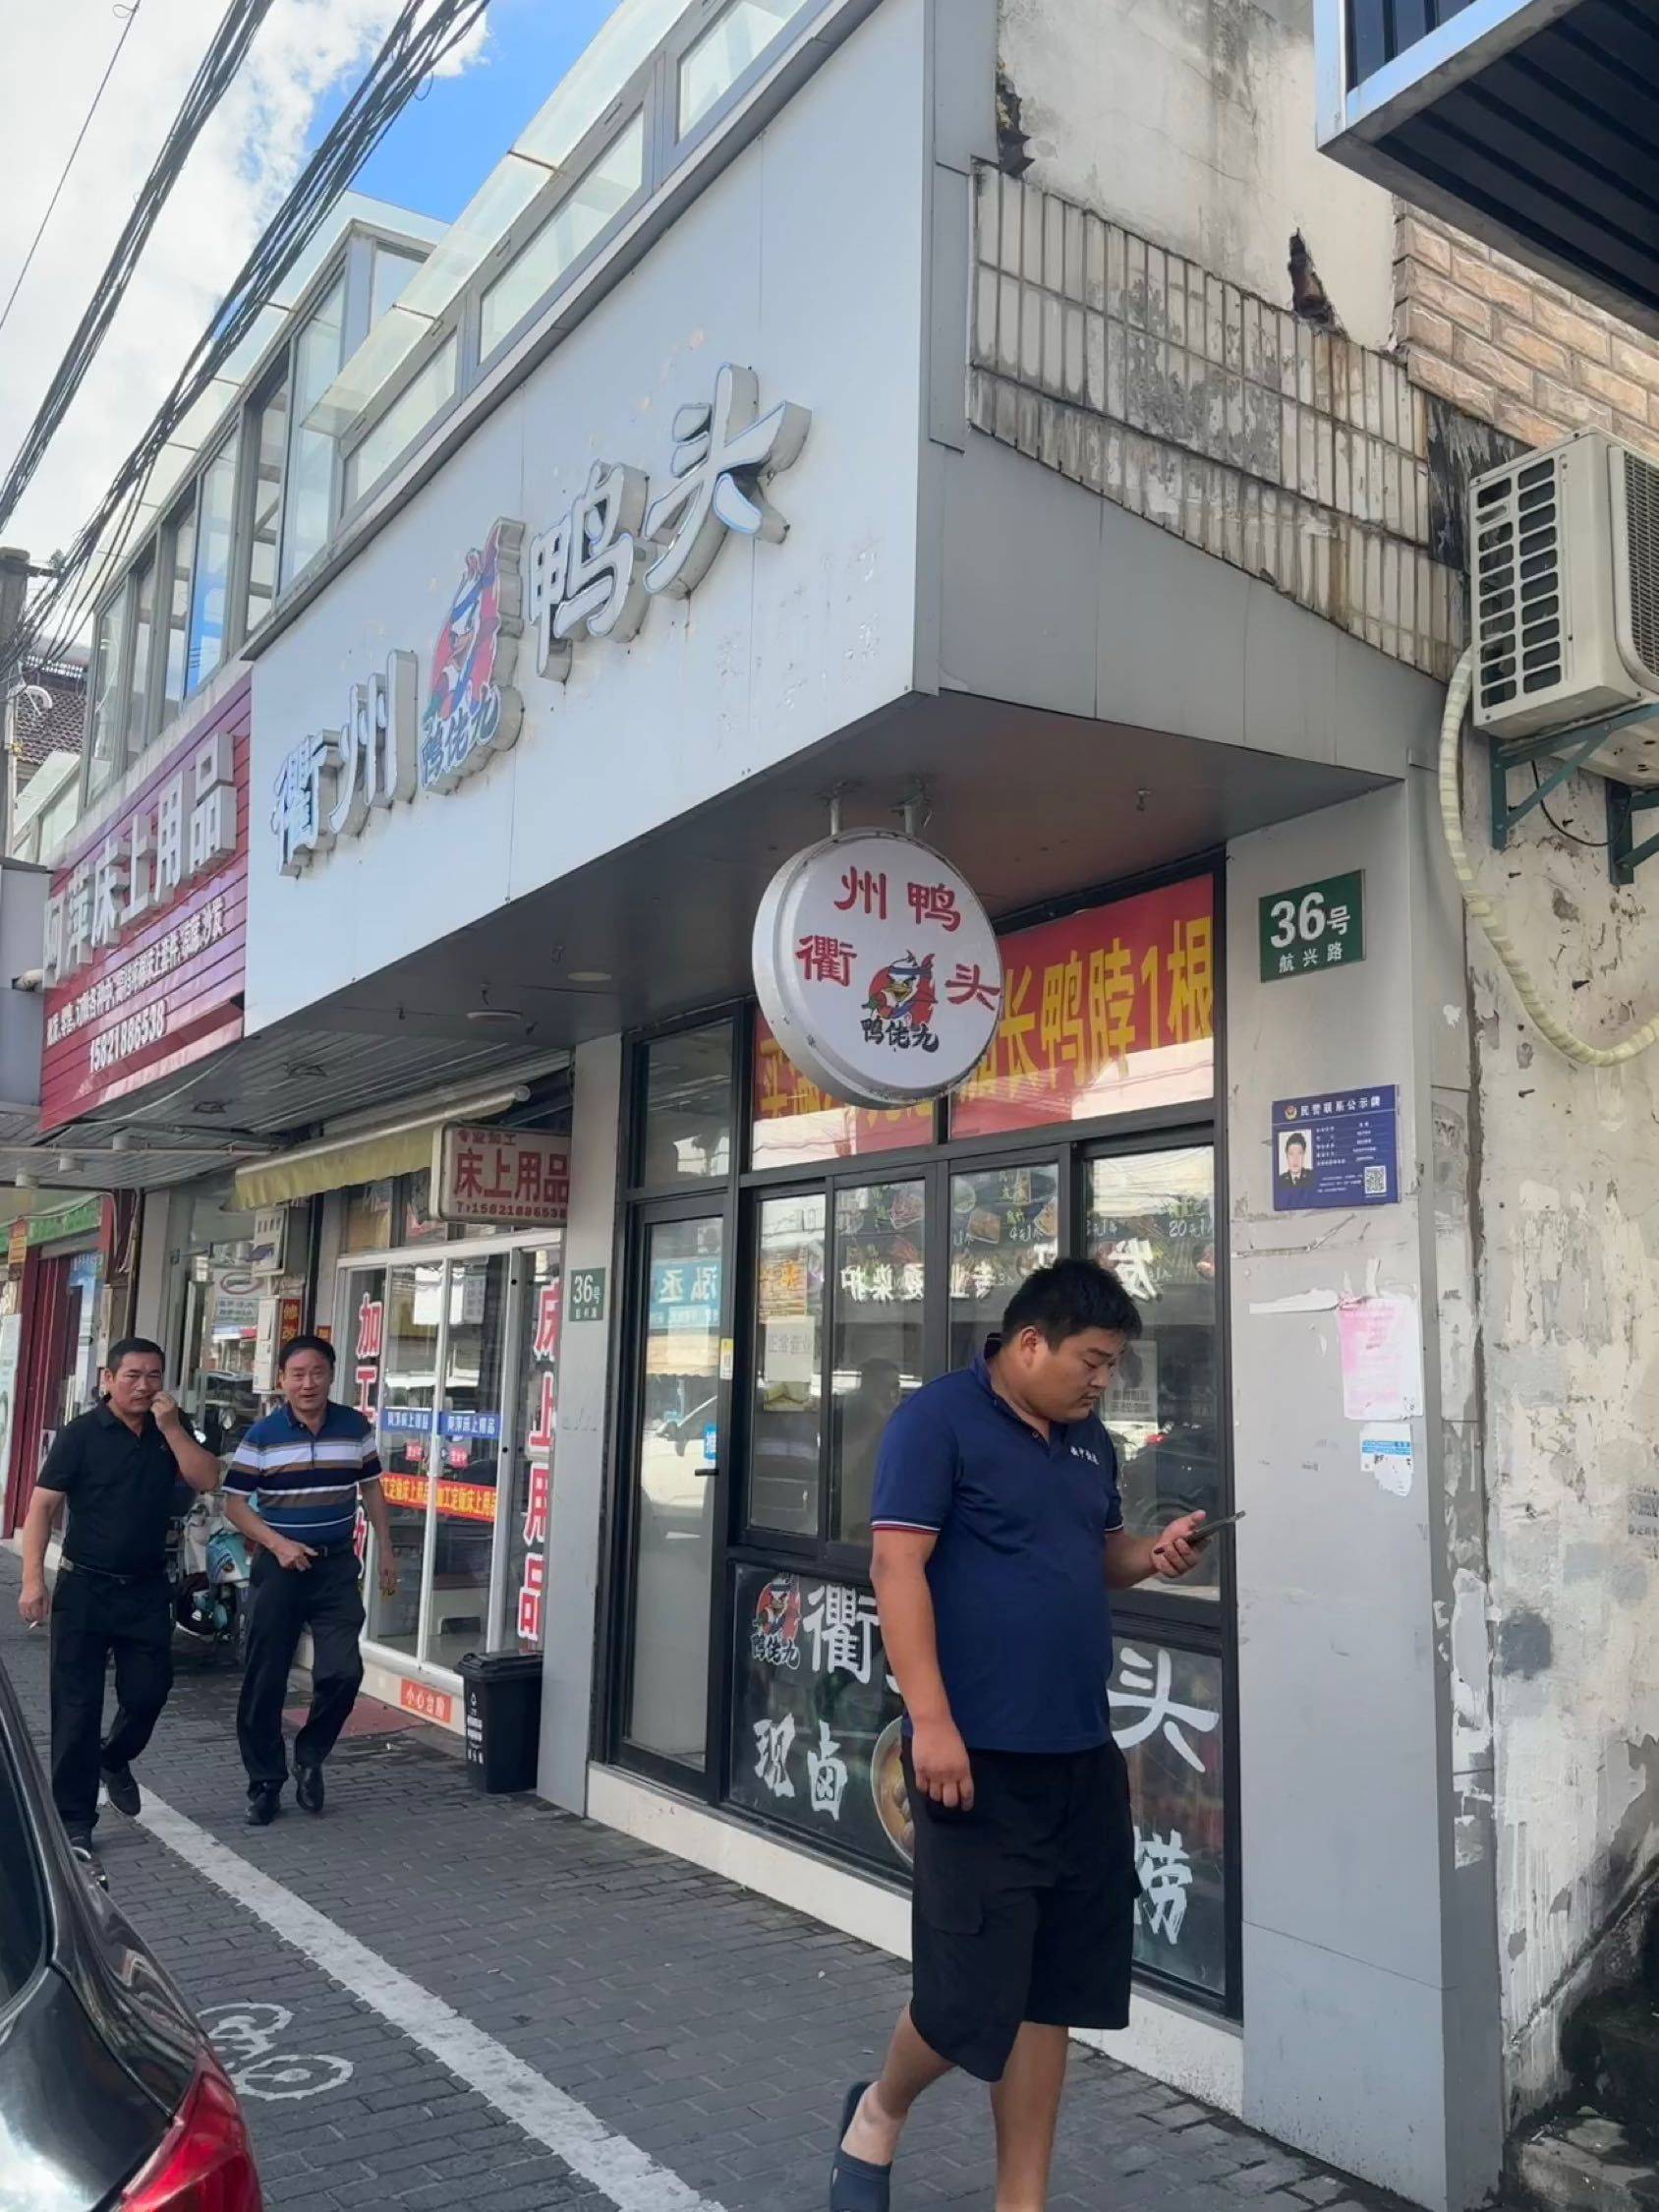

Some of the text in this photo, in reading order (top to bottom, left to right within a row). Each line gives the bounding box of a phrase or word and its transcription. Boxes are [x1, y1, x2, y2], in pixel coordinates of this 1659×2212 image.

[528, 362, 812, 682] 鸭头
[1270, 891, 1351, 949] 36号
[1279, 941, 1344, 974] 航兴路
[454, 1147, 570, 1205] 床上用品
[573, 1274, 601, 1306] 36号
[1107, 1646, 1220, 1773] 头
